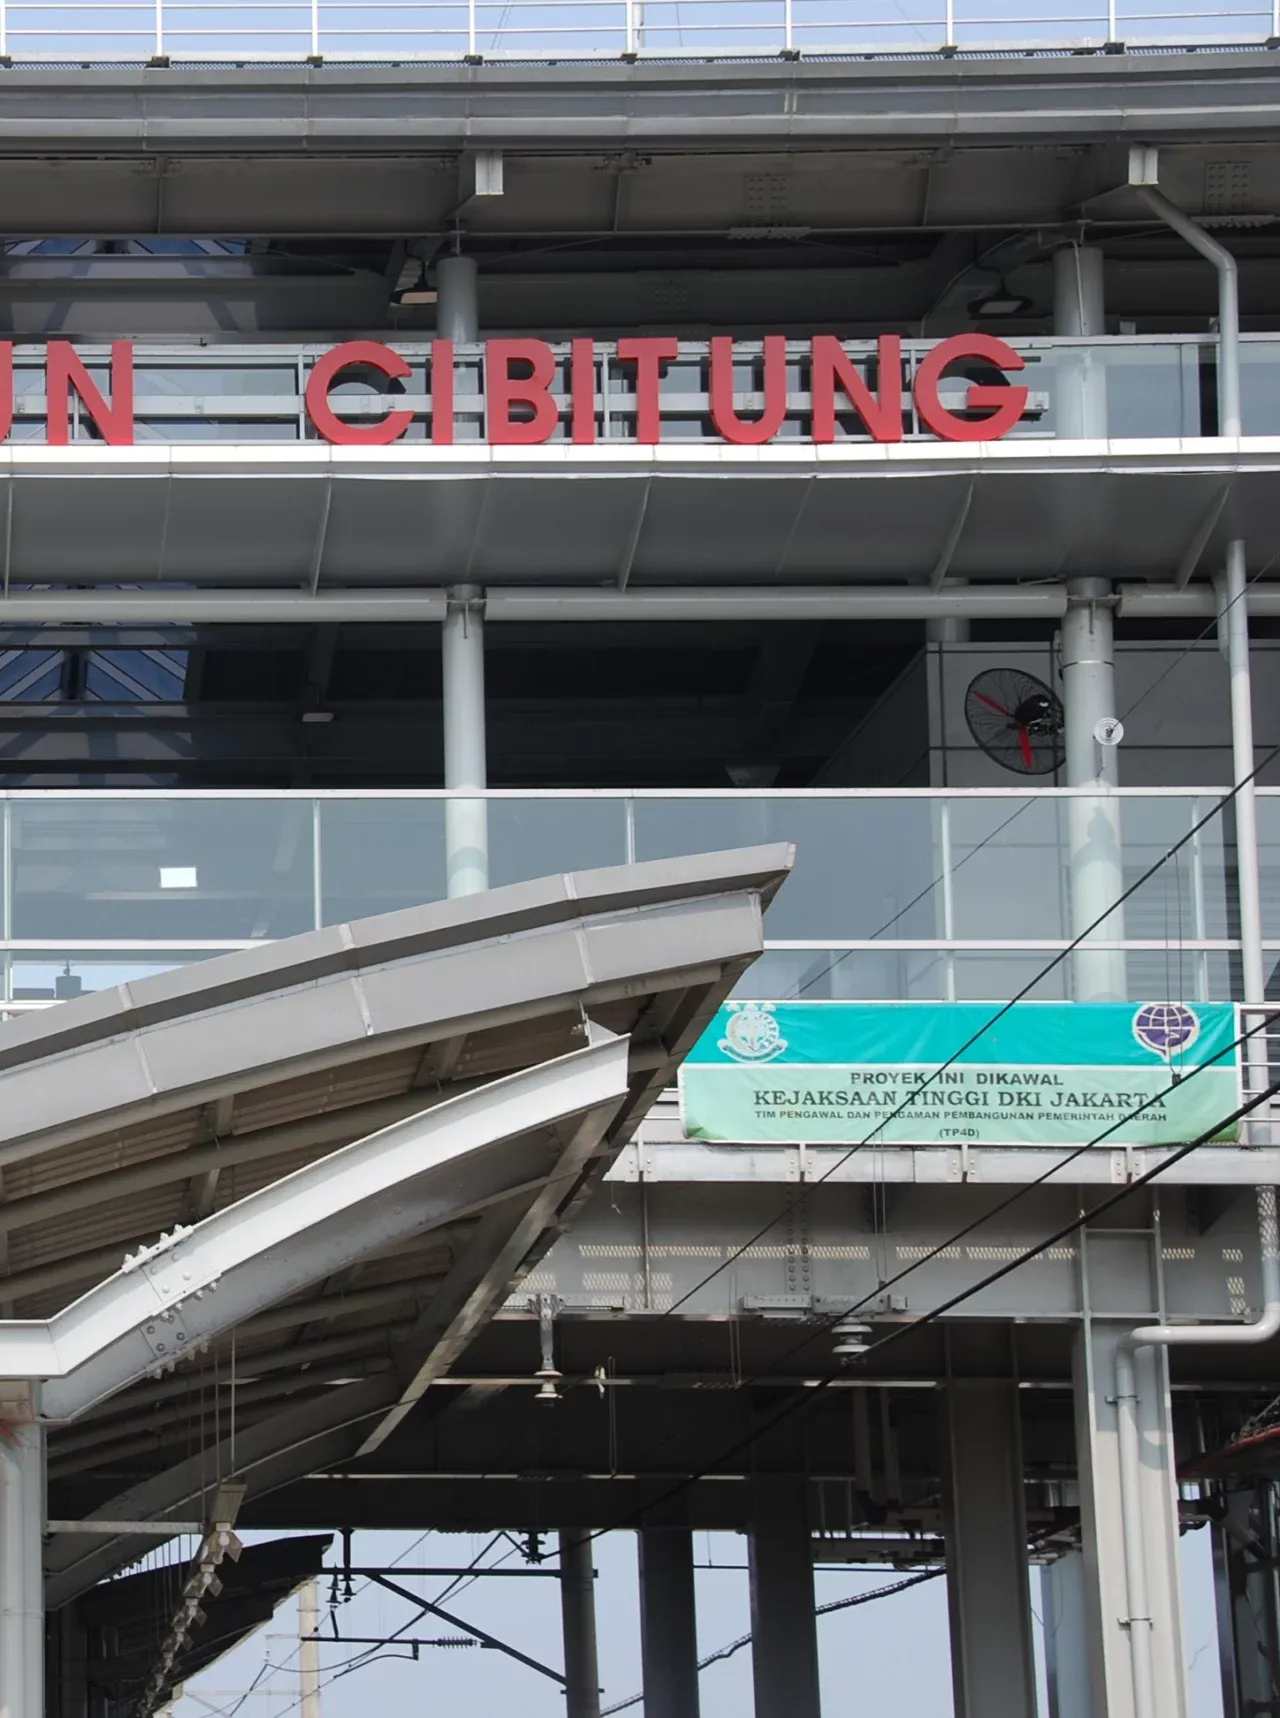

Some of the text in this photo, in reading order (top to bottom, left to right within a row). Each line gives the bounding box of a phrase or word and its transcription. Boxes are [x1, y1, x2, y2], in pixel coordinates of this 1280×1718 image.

[304, 333, 1028, 446] CIBITUNG
[851, 1072, 1064, 1086] PROYEK INI DIKAWAL
[754, 1090, 1166, 1108] KEJAKSAAN TINGGI DKI JAKARTA
[755, 1110, 776, 1119] TIM
[779, 1110, 843, 1119] PENGAWAL
[847, 1111, 870, 1119] DAN
[943, 1111, 1034, 1120] PEMBANGUNAN
[1038, 1112, 1114, 1121] PEMERINTAH
[939, 1128, 980, 1138] (TP4D)
